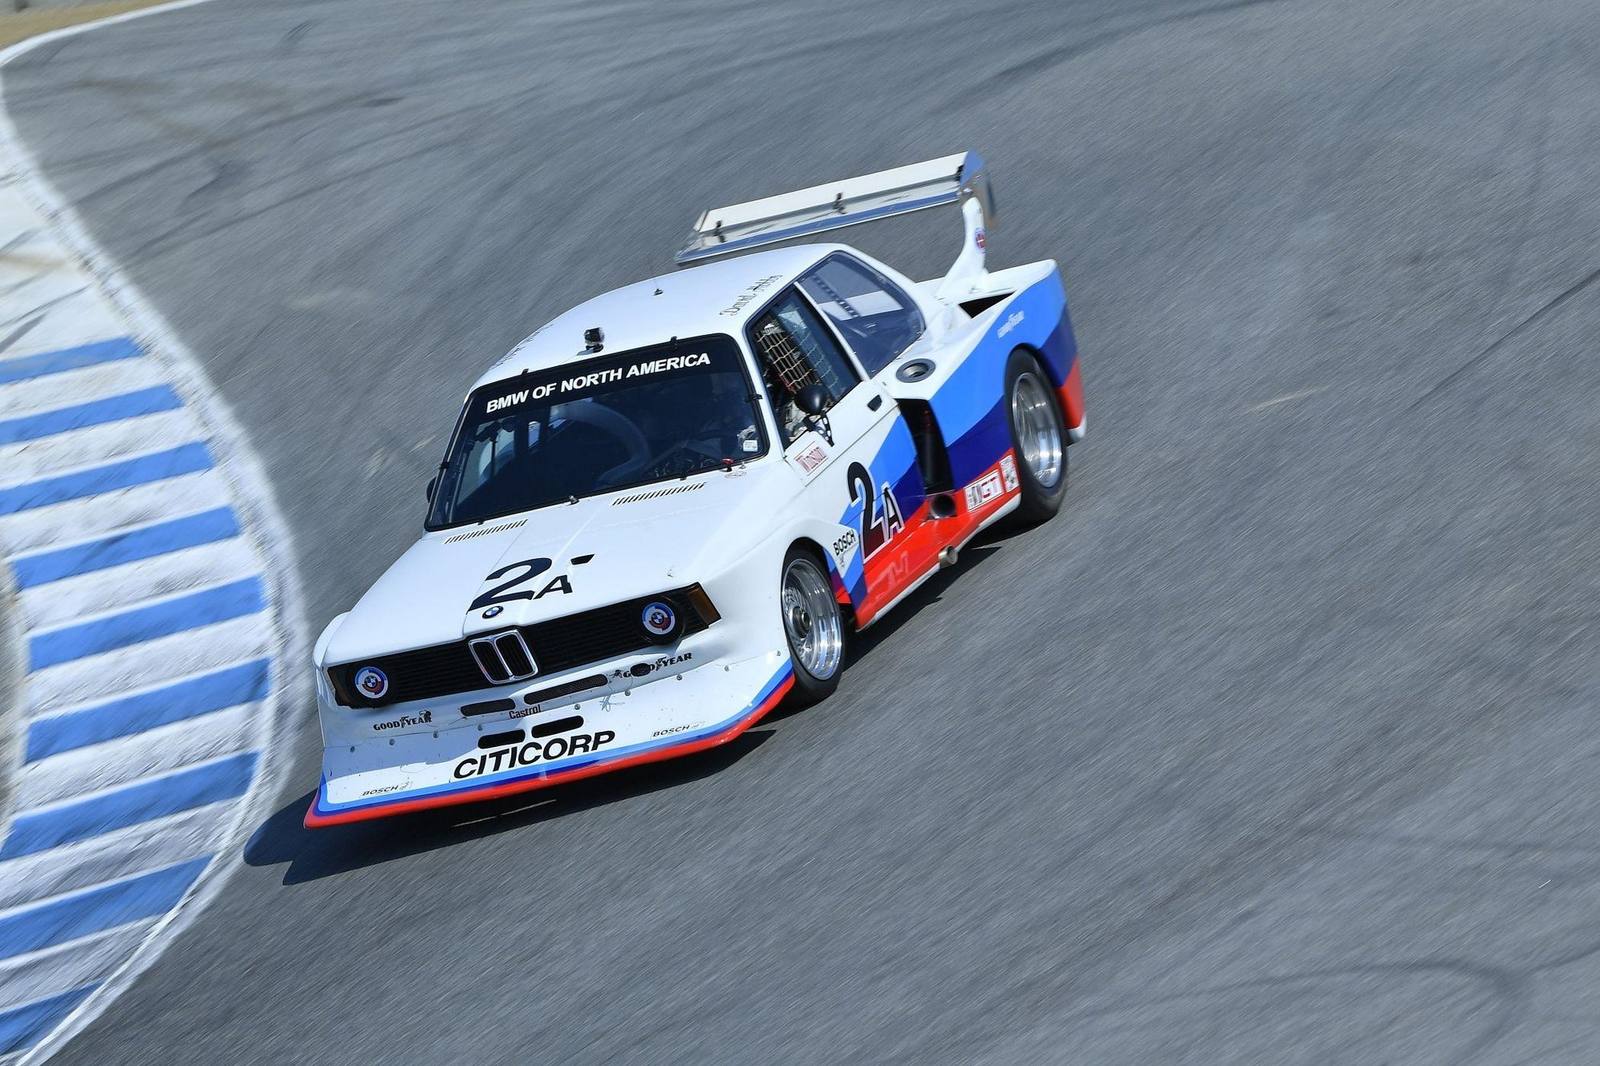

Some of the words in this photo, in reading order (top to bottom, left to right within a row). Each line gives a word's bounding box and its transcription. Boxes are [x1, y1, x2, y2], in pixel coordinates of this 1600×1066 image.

[486, 390, 529, 413] BMW
[532, 383, 557, 400] OF
[560, 368, 622, 392] NORTH
[626, 352, 711, 378] AMERICA
[833, 530, 856, 556] BOSCH
[623, 652, 692, 678] GDYEAR
[508, 704, 541, 720] Castrol
[652, 724, 690, 737] BOSCH
[453, 730, 616, 779] CITICORP
[362, 784, 399, 796] BOSCH
